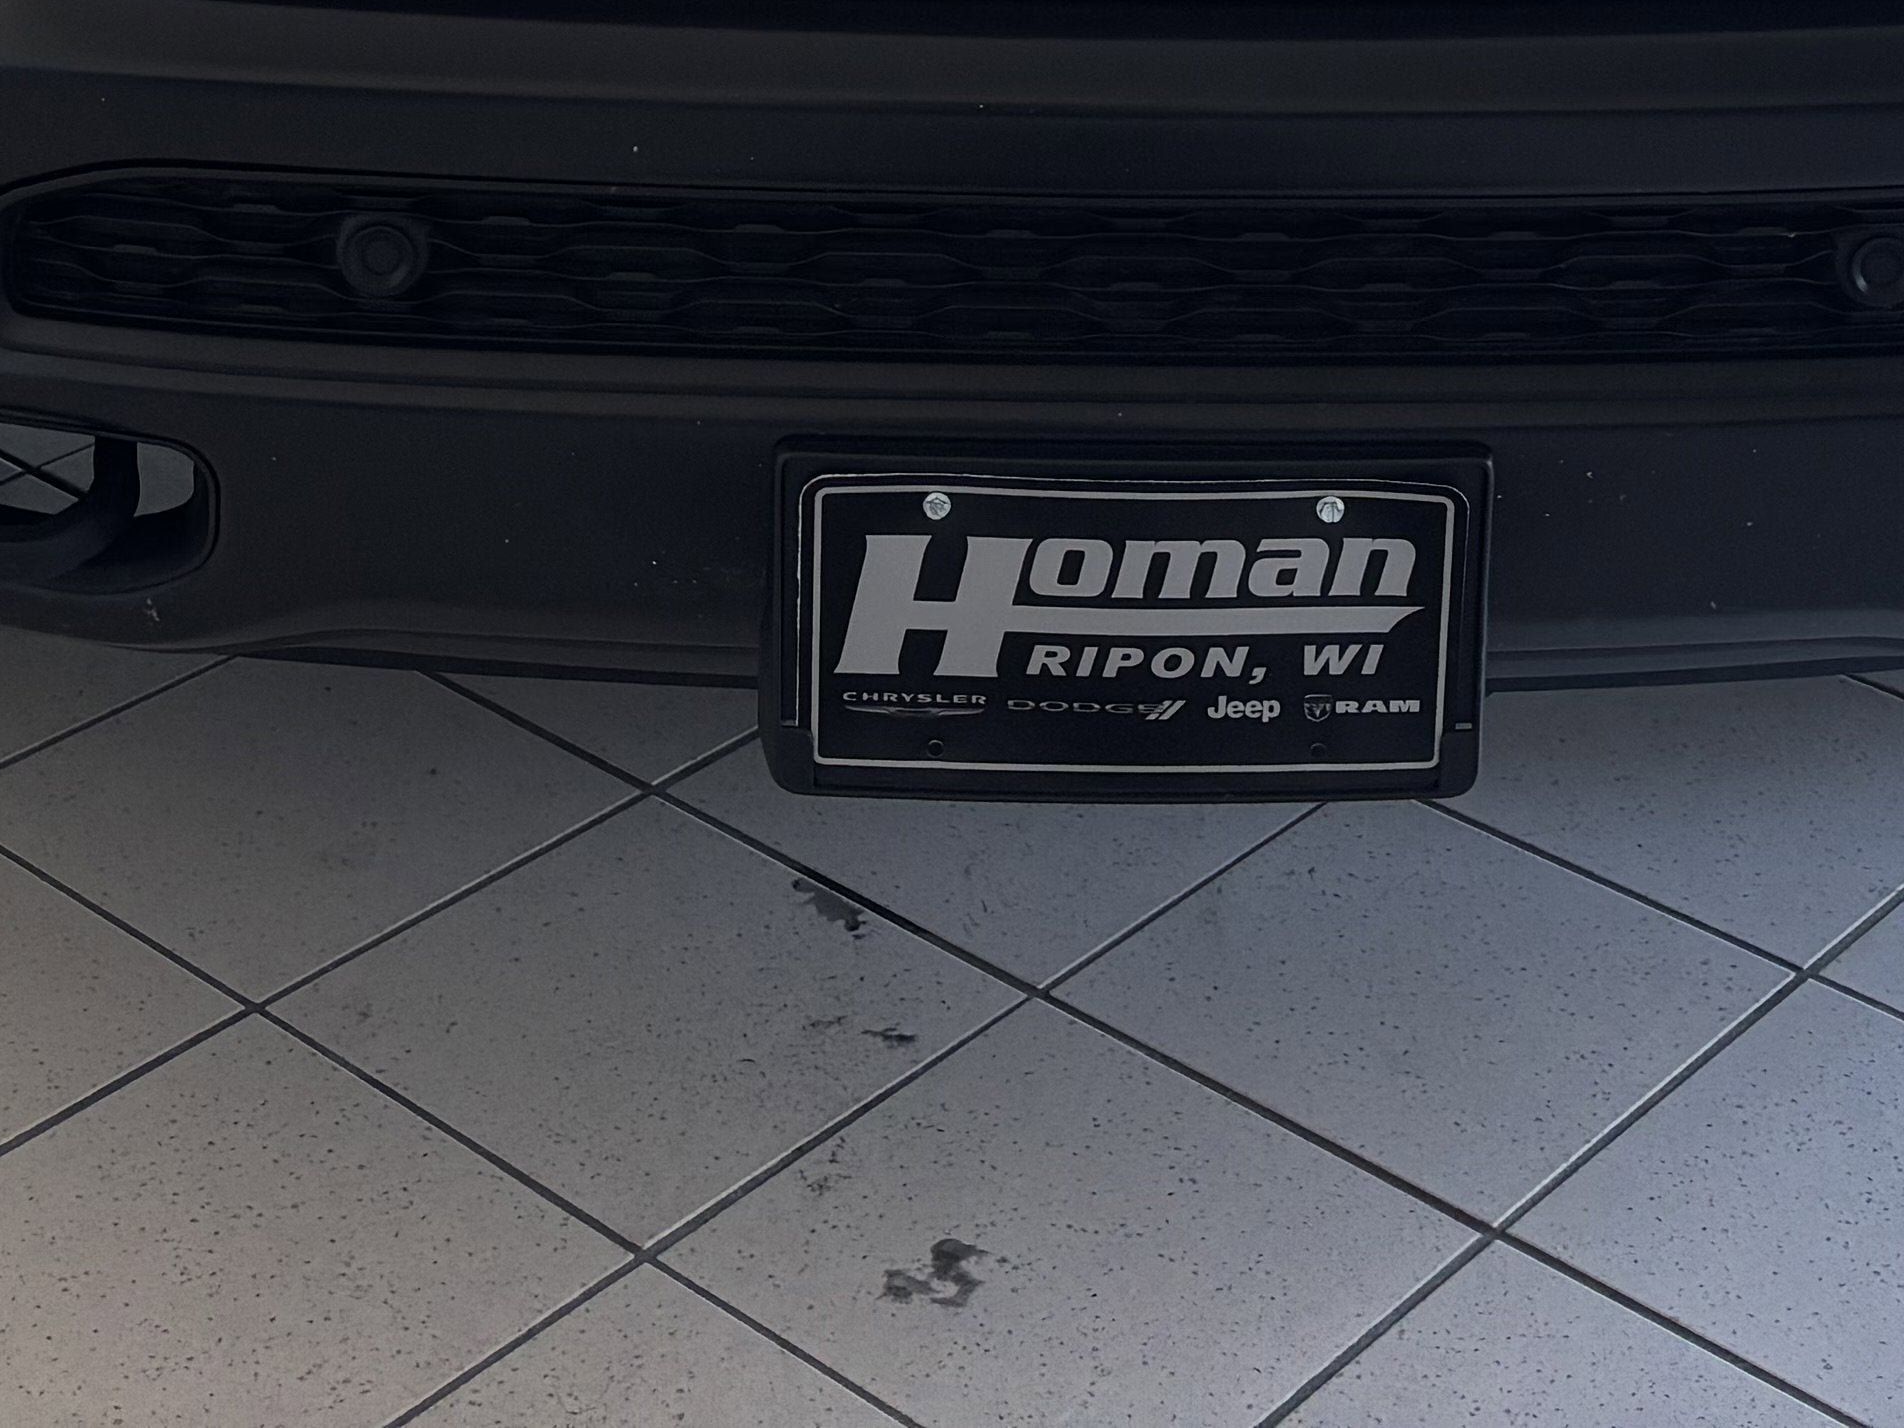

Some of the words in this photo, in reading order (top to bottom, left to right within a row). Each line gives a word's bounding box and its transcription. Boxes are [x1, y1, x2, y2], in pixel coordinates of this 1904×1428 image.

[833, 533, 1425, 676] Homan
[1026, 643, 1268, 684] RIPON,
[1302, 644, 1386, 675] WI
[843, 691, 987, 705] CHRYSLER
[1007, 699, 1165, 715] DODGE
[1207, 695, 1281, 723] Jeep
[1335, 700, 1421, 714] RAM
